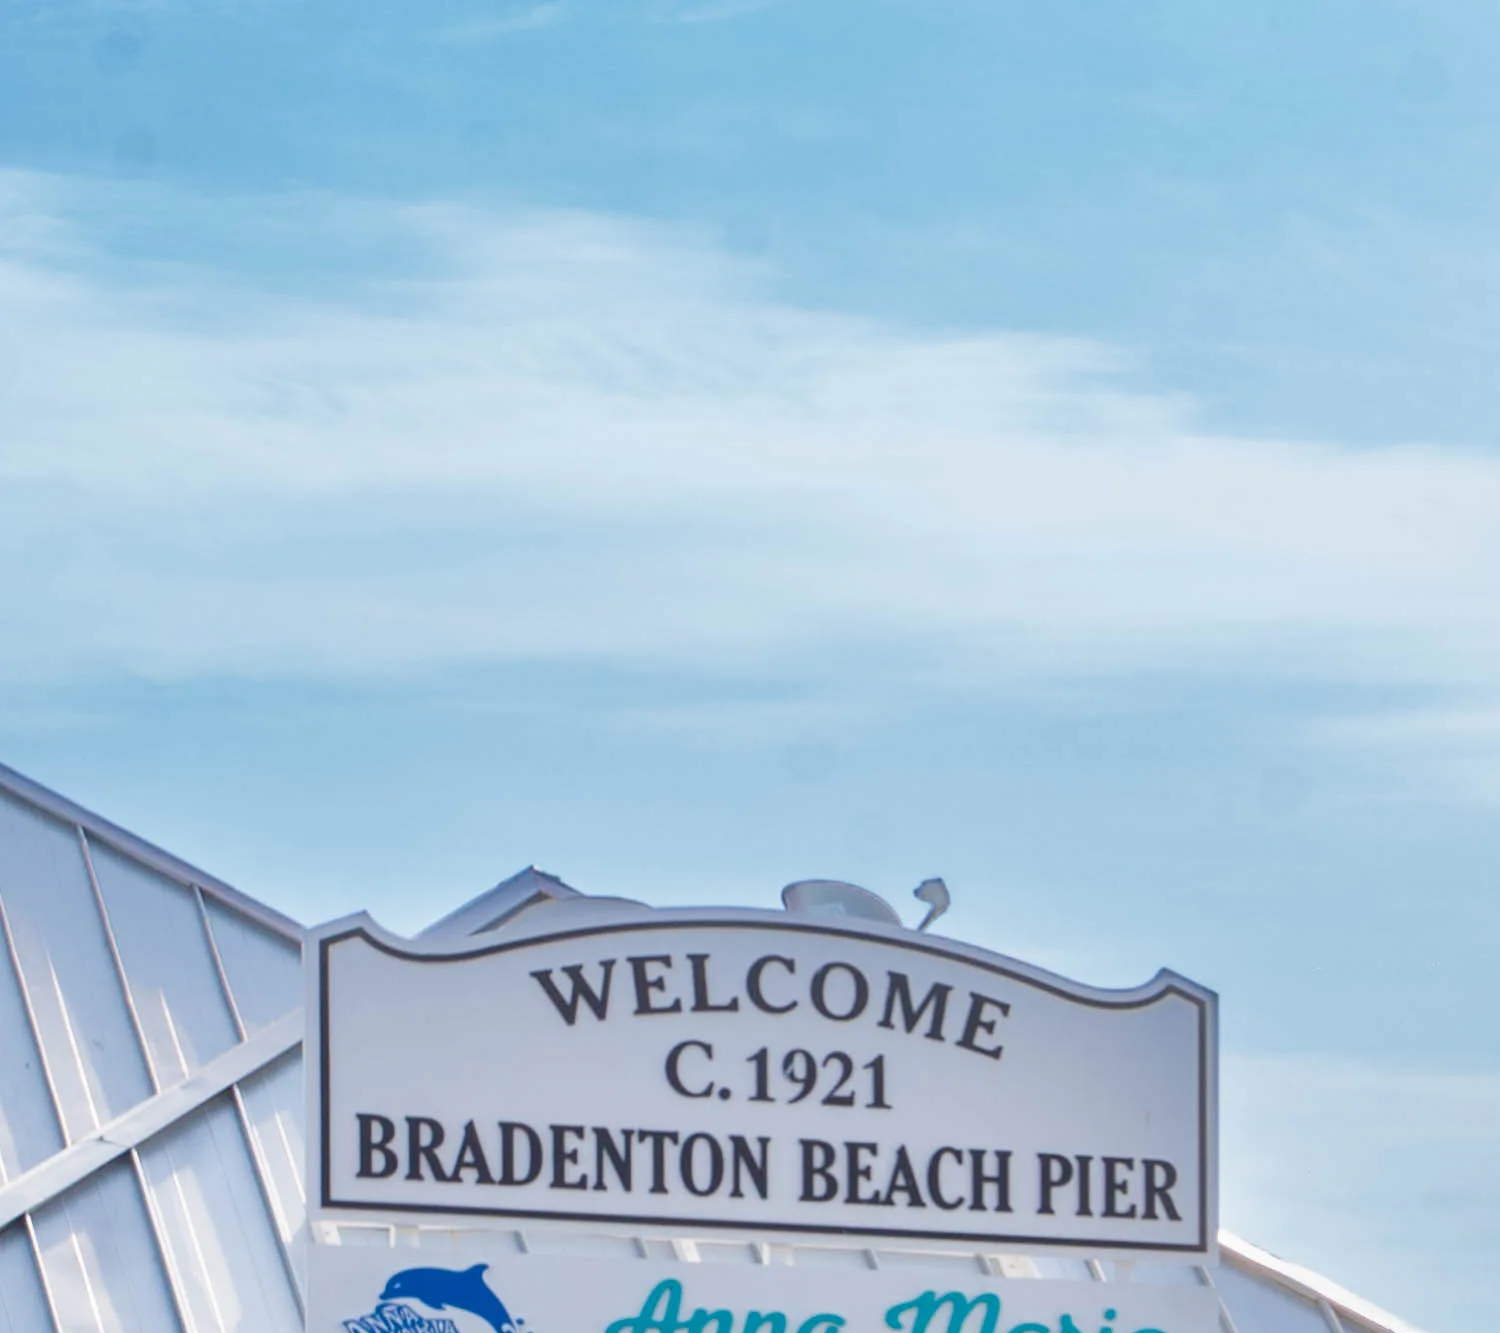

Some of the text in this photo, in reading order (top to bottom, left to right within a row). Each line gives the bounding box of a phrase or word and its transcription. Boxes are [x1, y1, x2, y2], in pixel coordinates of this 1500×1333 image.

[531, 953, 1011, 1060] WELCOME
[355, 1113, 1182, 1222] BRADENTON BEACH PIER
